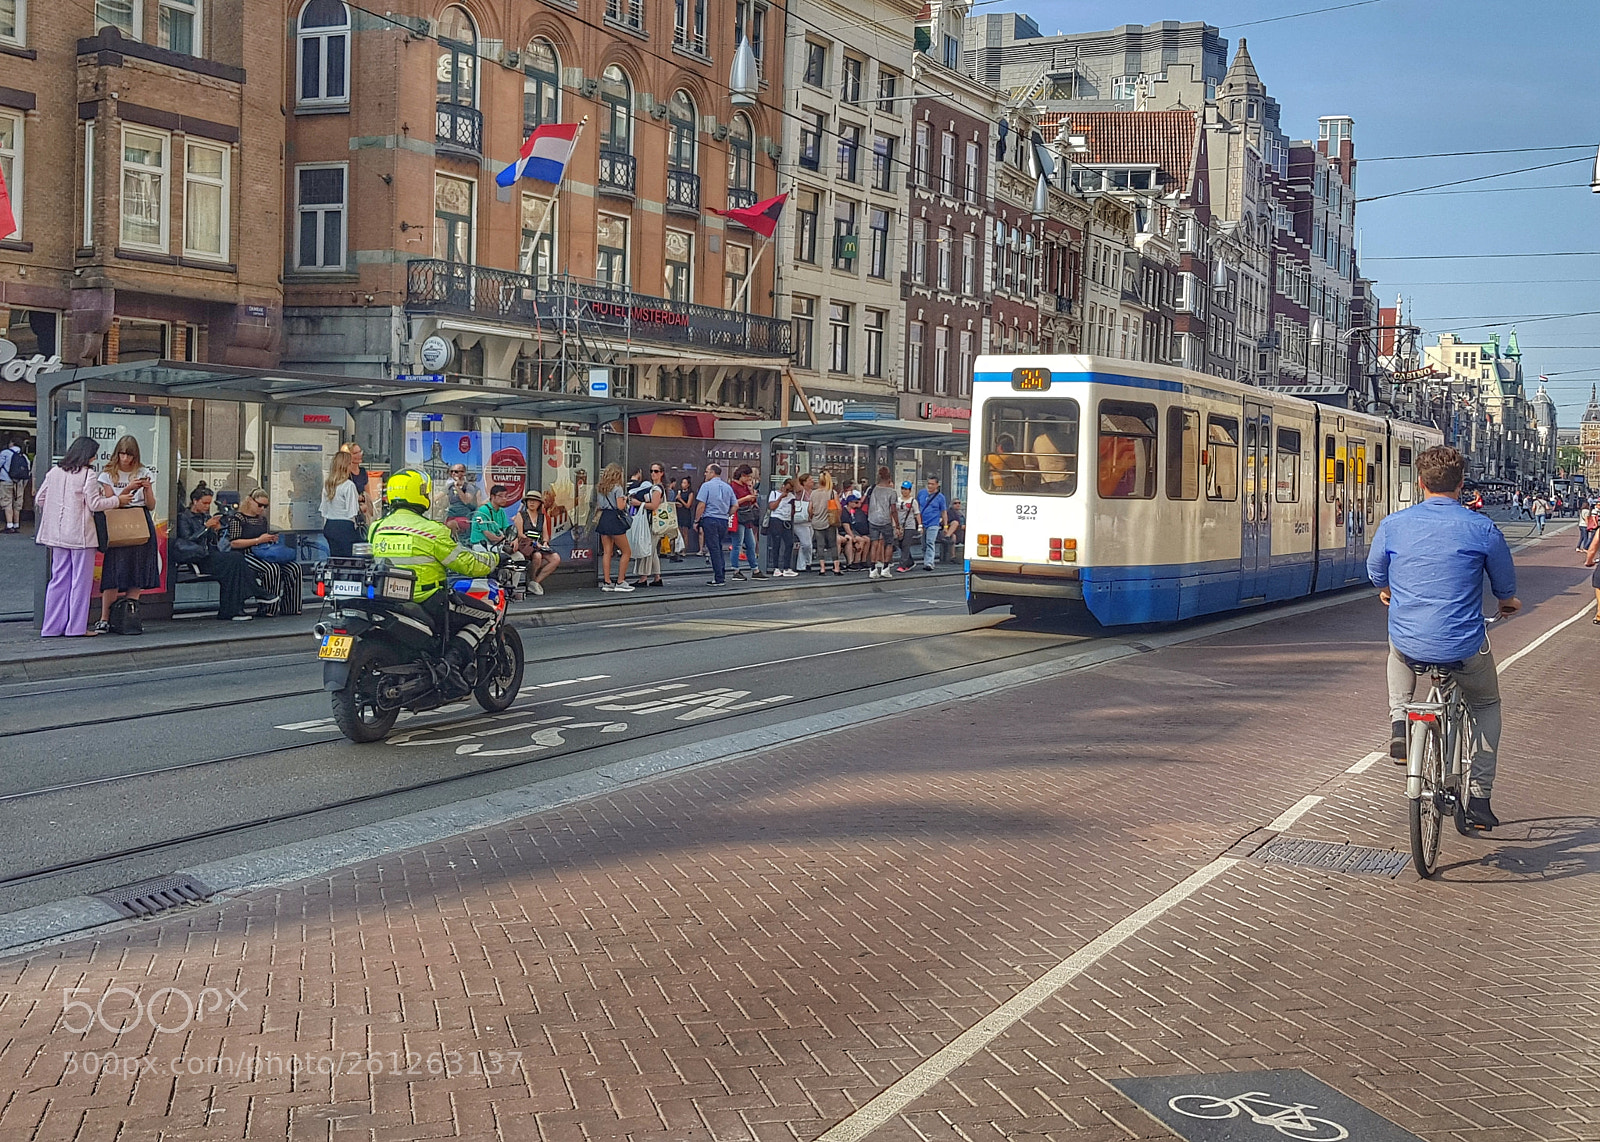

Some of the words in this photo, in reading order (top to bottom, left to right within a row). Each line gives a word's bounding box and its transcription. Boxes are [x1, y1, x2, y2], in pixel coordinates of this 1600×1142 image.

[592, 302, 626, 318] HOTEL
[630, 306, 690, 327] AMSTERDAM
[1021, 369, 1042, 389] 24
[1393, 367, 1431, 380] CASINO
[793, 394, 856, 416] McDona
[89, 427, 117, 440] DEEZER
[565, 440, 581, 453] FILL
[564, 454, 582, 468] UP
[706, 450, 738, 459] HOTEL
[493, 474, 521, 482] KWARTIER
[1015, 504, 1038, 515] 823
[571, 549, 589, 559] KFC
[334, 584, 361, 592] POLITIE
[333, 637, 345, 647] 61
